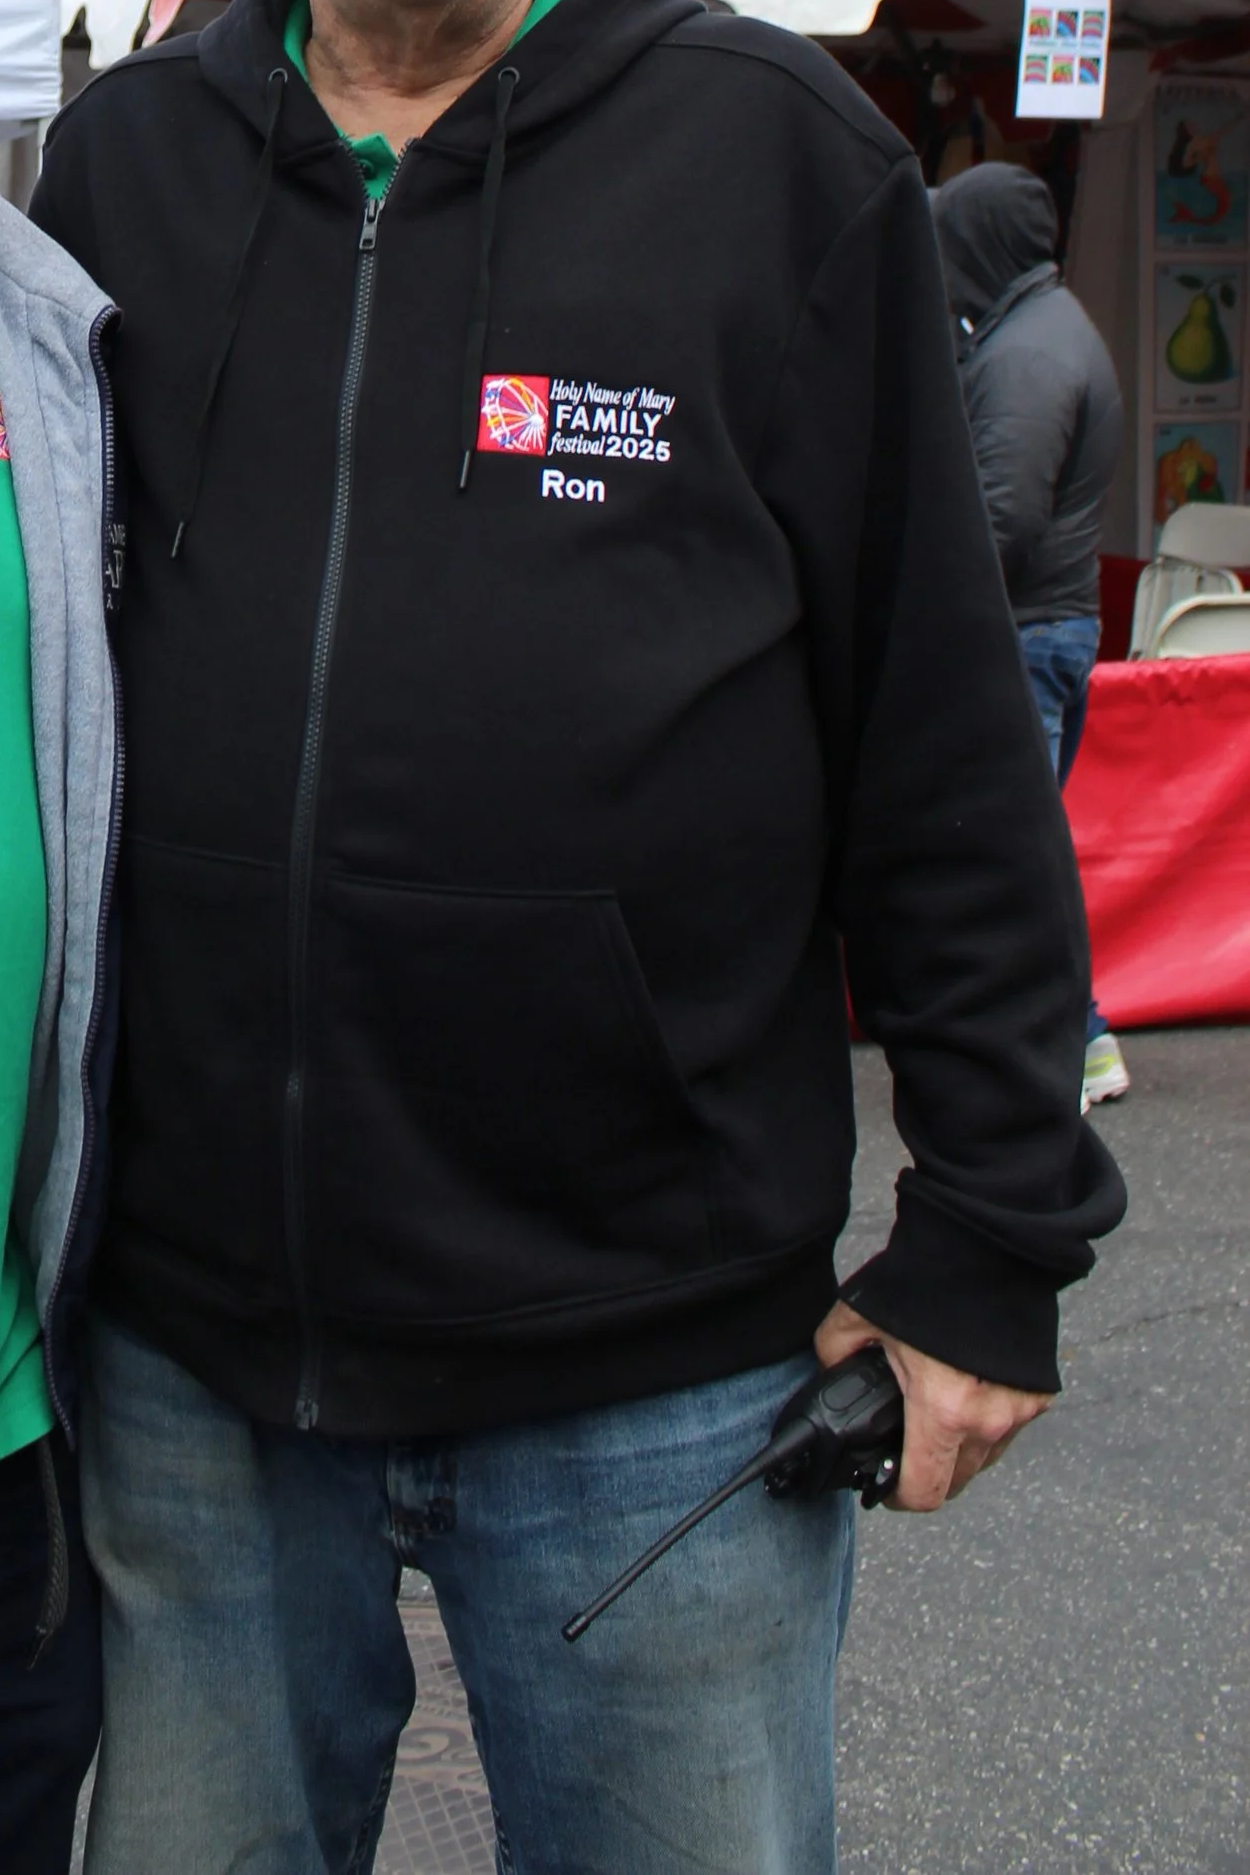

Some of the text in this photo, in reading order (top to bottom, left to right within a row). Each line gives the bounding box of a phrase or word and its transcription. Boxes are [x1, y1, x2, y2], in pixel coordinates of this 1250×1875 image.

[550, 379, 675, 416] Holy Name of Mary
[556, 404, 662, 438] FAMILY
[547, 431, 671, 462] festival 2025
[541, 469, 605, 503] Ron
